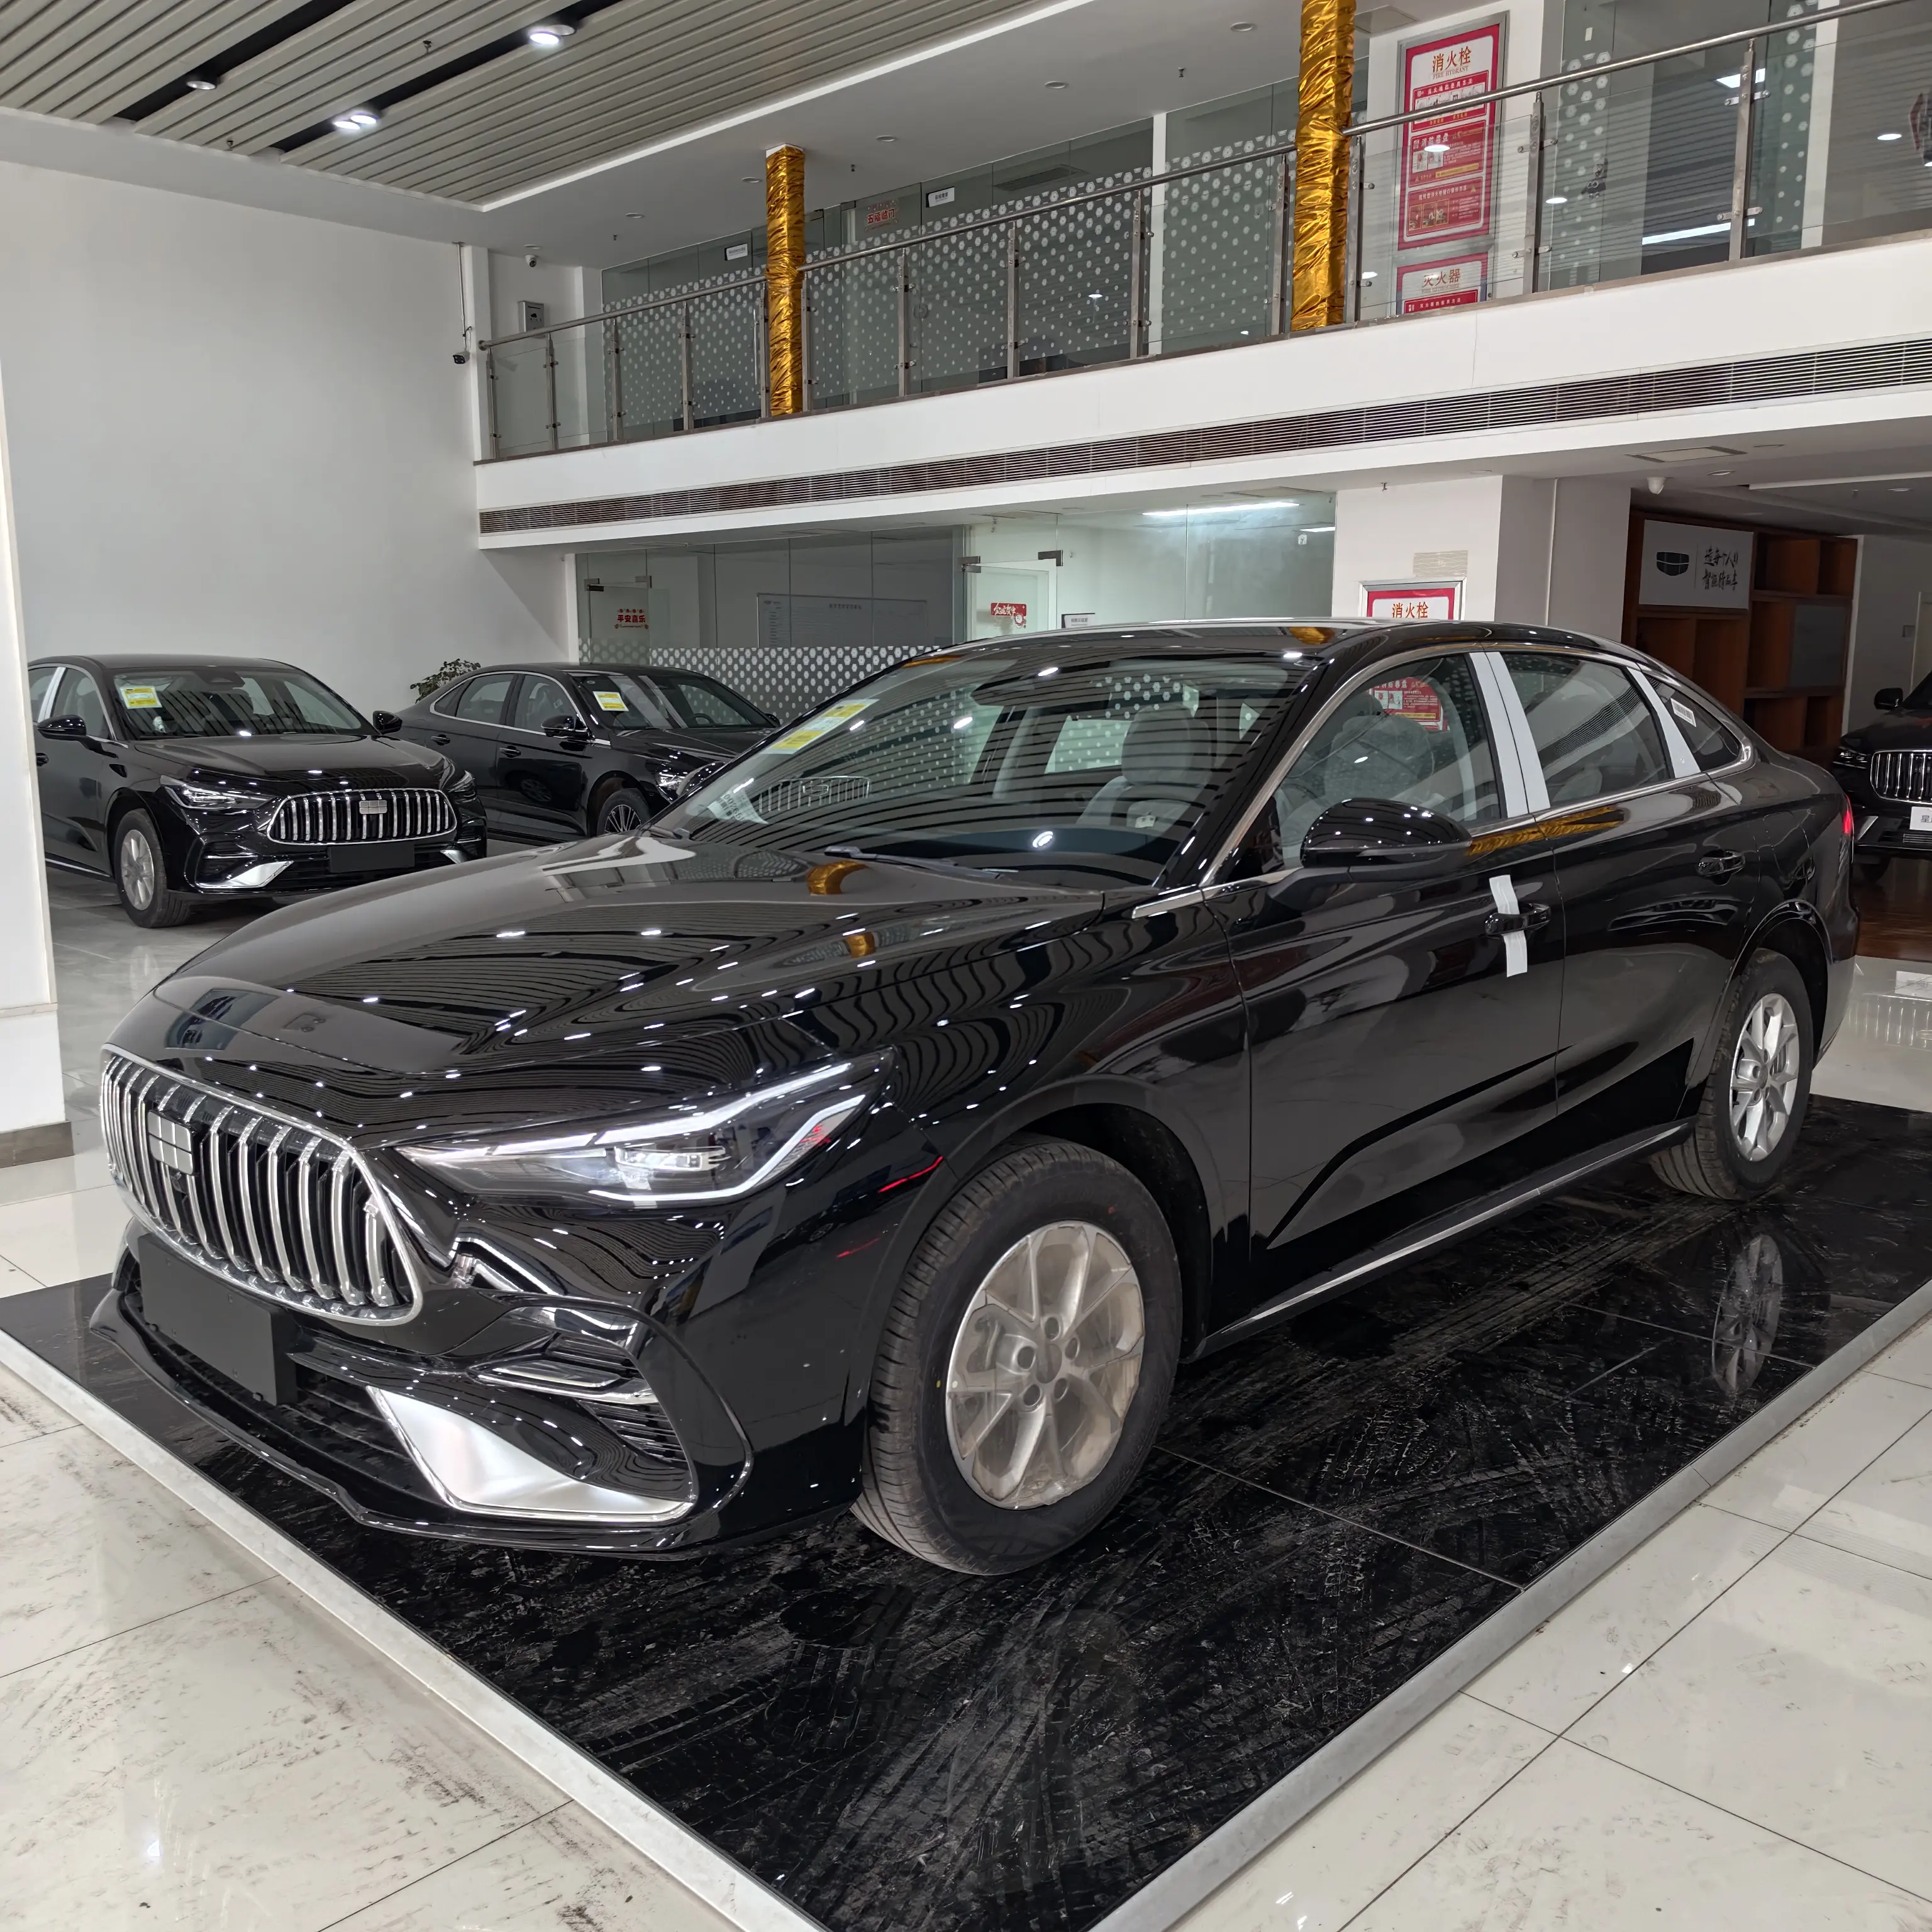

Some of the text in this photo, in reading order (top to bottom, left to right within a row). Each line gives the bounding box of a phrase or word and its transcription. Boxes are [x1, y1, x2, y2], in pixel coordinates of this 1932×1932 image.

[1433, 46, 1472, 72] 消火栓
[1433, 65, 1468, 80] FIRE HYDRANT
[1423, 269, 1460, 287] 灭火器
[617, 614, 645, 623] 平安喜乐
[1392, 602, 1429, 619] 消火栓
